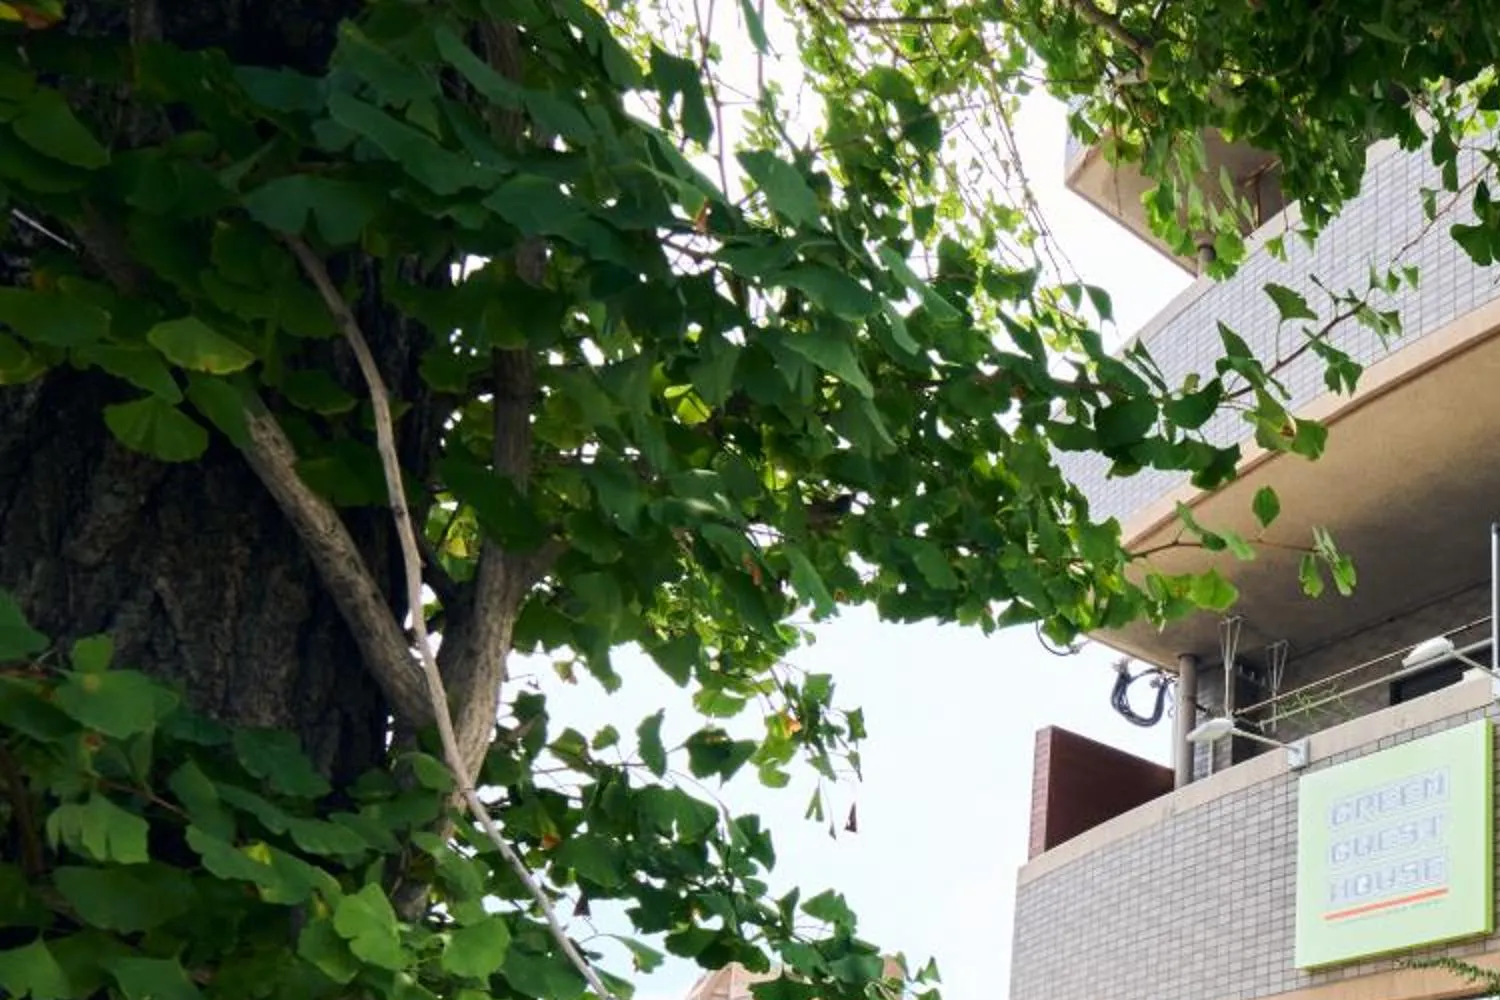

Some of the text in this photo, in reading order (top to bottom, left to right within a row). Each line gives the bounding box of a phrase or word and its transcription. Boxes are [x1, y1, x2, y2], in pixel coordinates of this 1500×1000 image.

[1330, 771, 1445, 827] GREEN
[1330, 815, 1442, 864] GUEST
[1330, 856, 1444, 902] HOUSE
